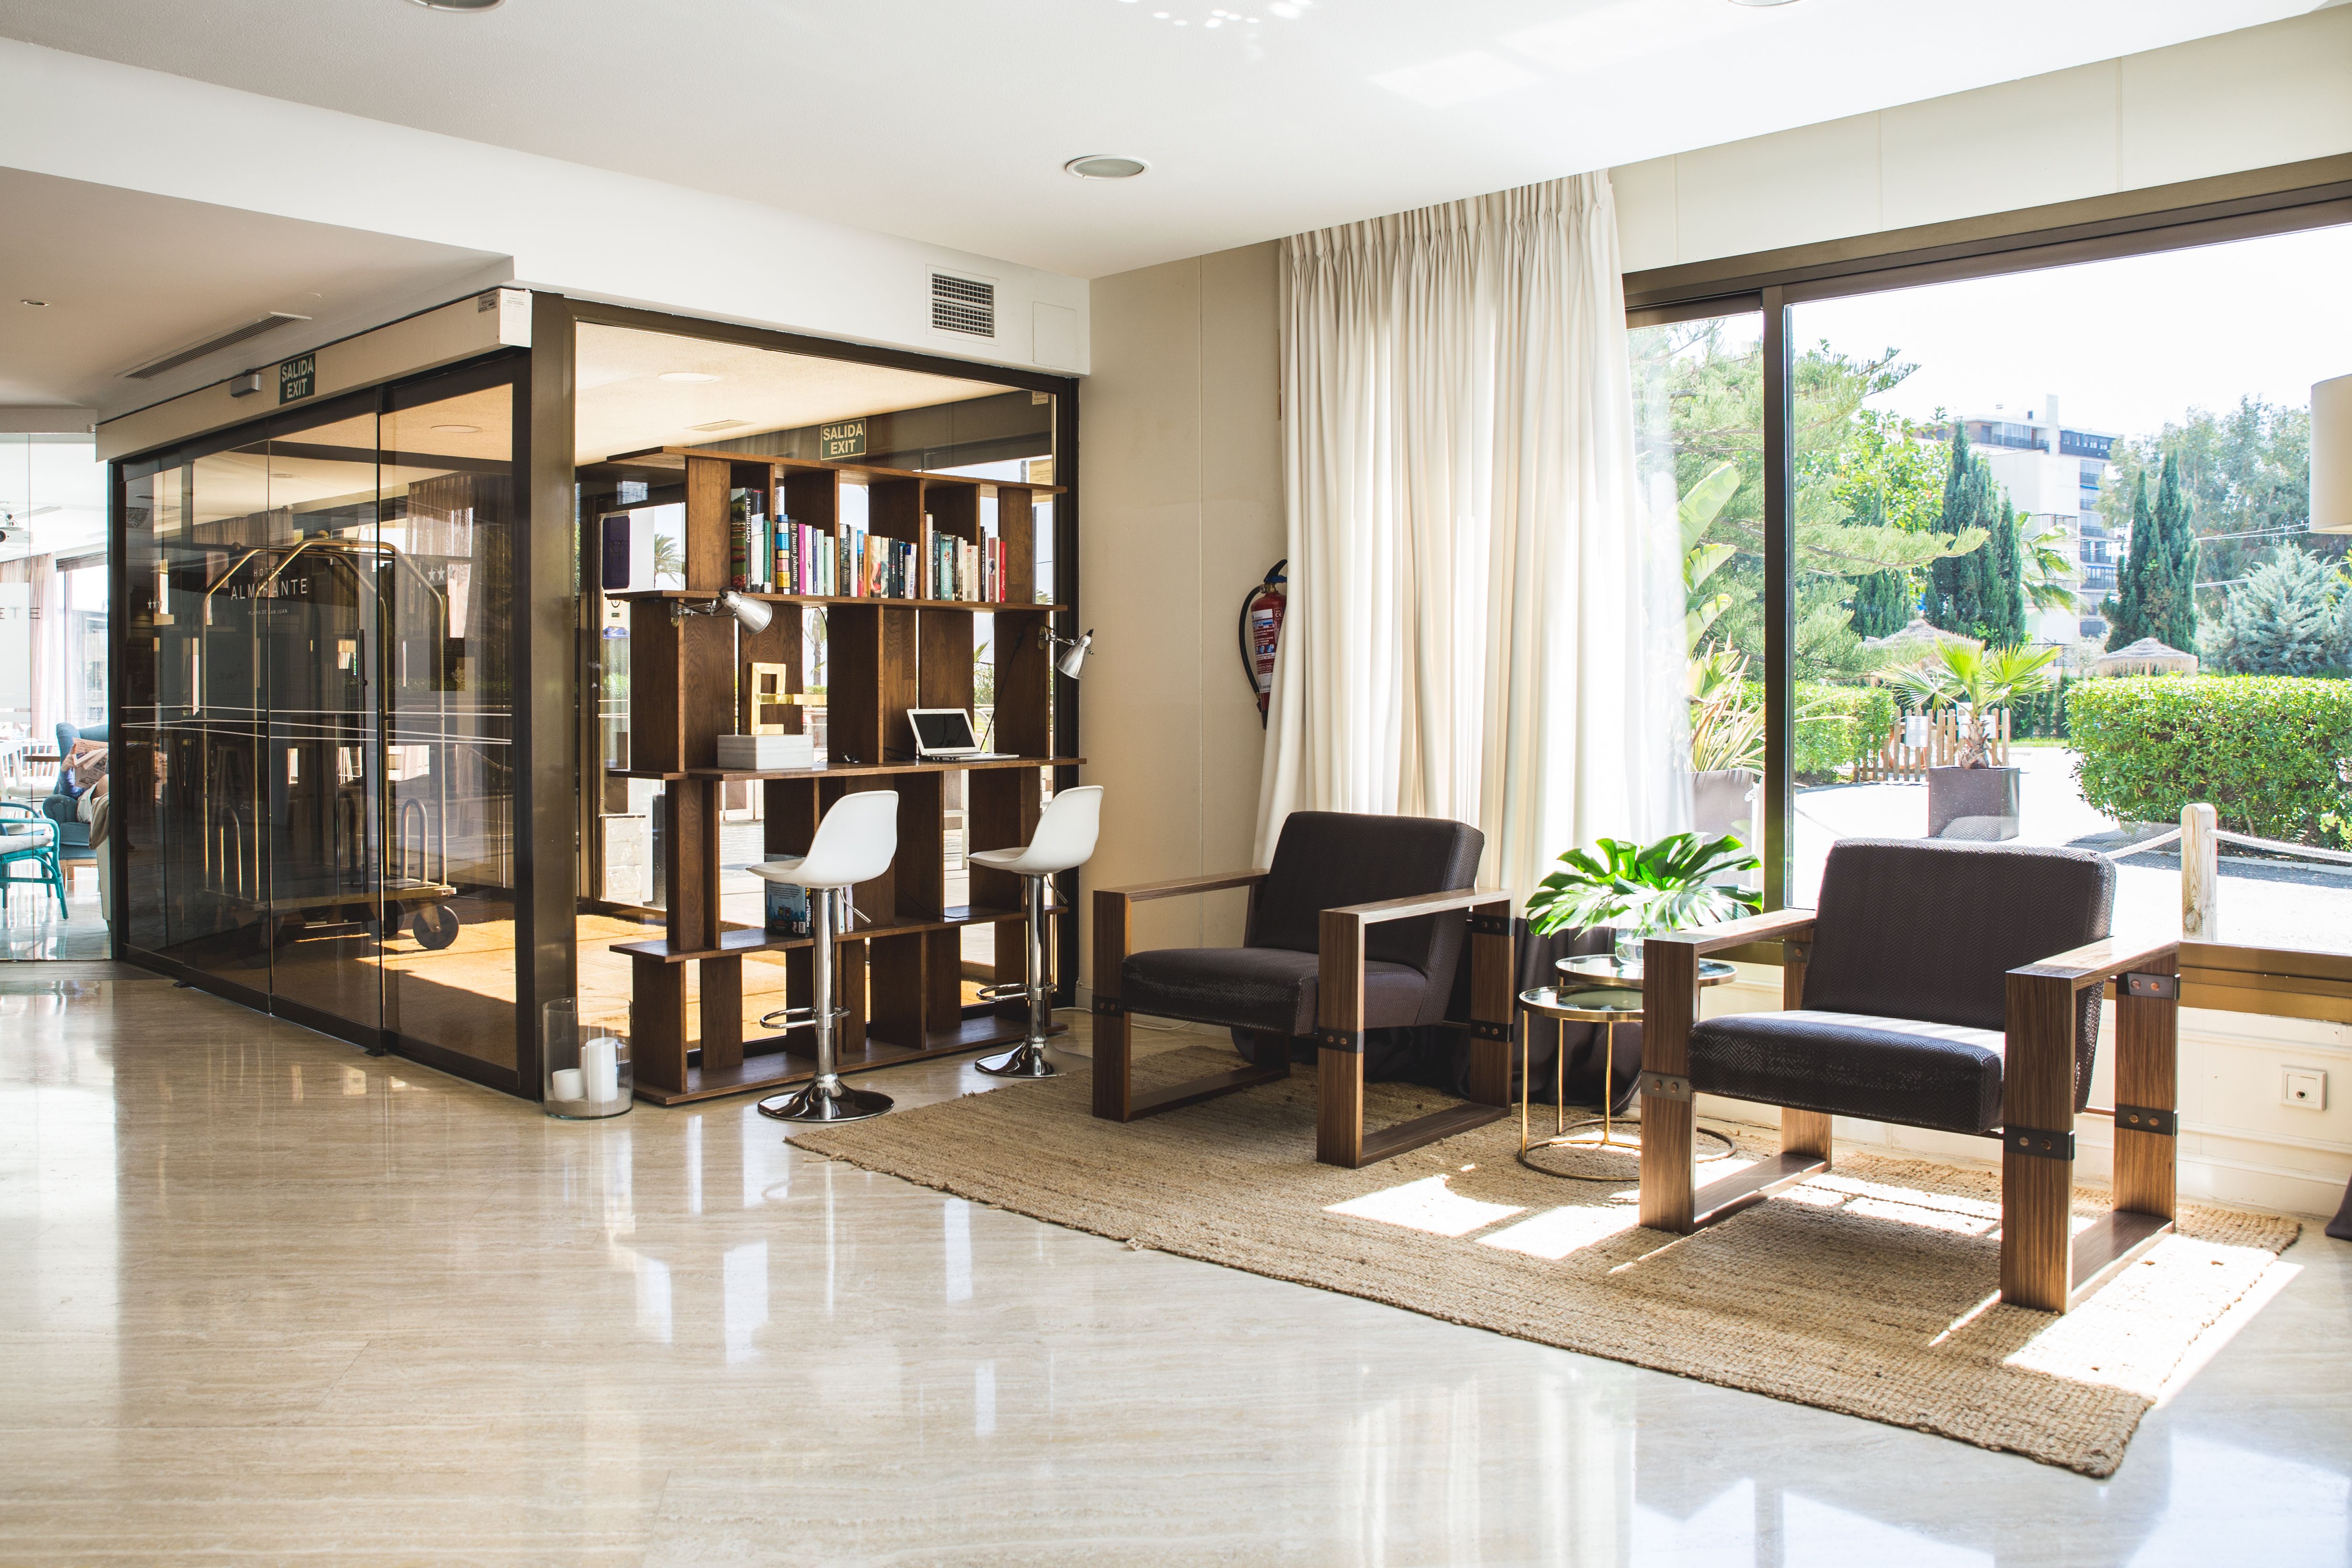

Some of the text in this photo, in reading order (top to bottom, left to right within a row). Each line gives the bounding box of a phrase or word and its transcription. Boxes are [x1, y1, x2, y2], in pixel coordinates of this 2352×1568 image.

[281, 357, 314, 383] SALIDA
[287, 378, 307, 398] EXIT
[823, 423, 863, 440] SALIDA
[831, 439, 856, 455] EXIT
[231, 578, 307, 600] ALMIRANTE
